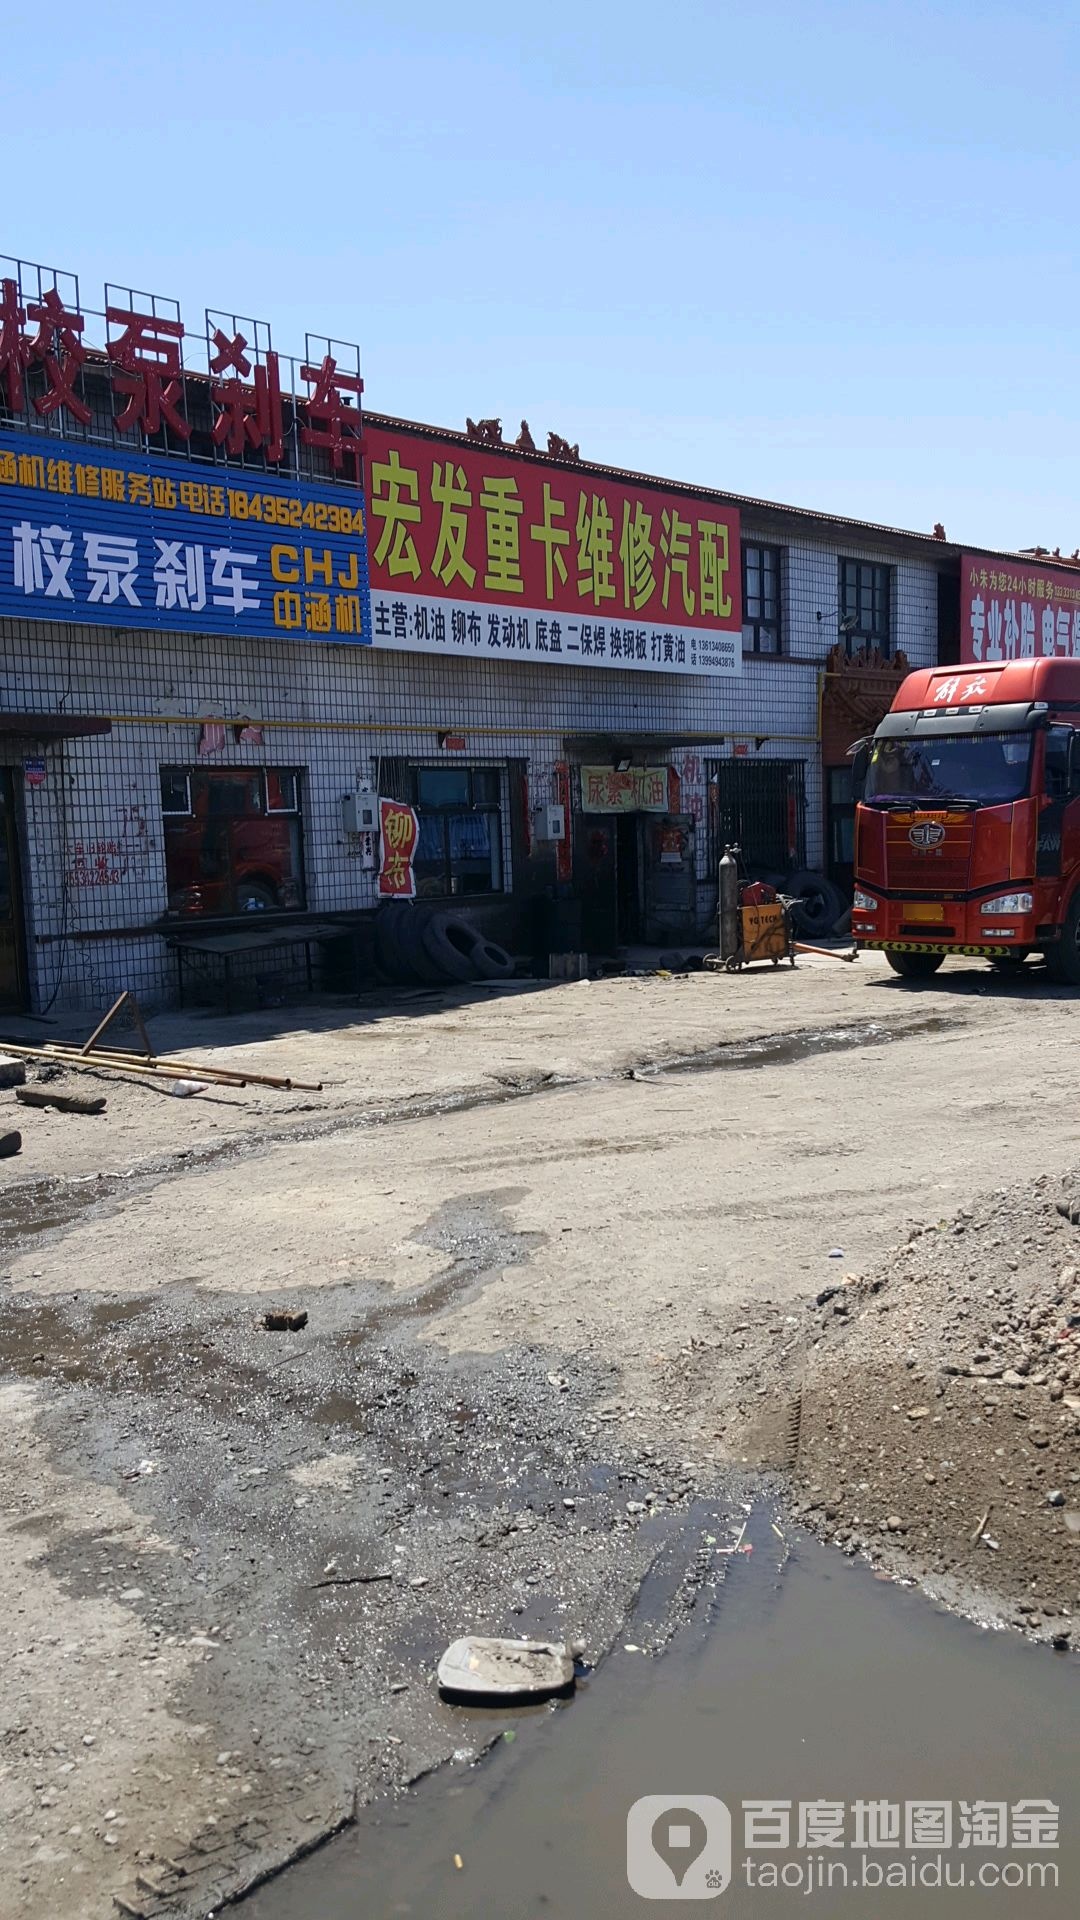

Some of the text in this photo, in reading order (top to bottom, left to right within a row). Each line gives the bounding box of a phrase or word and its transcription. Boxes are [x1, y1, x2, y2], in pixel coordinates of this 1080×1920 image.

[0, 277, 367, 469] 校泵刹车
[12, 520, 261, 615] 校泵刹车
[270, 543, 359, 590] CHJ
[371, 449, 733, 619] 宏发重卡维修汽配
[1037, 839, 1062, 852] FAW
